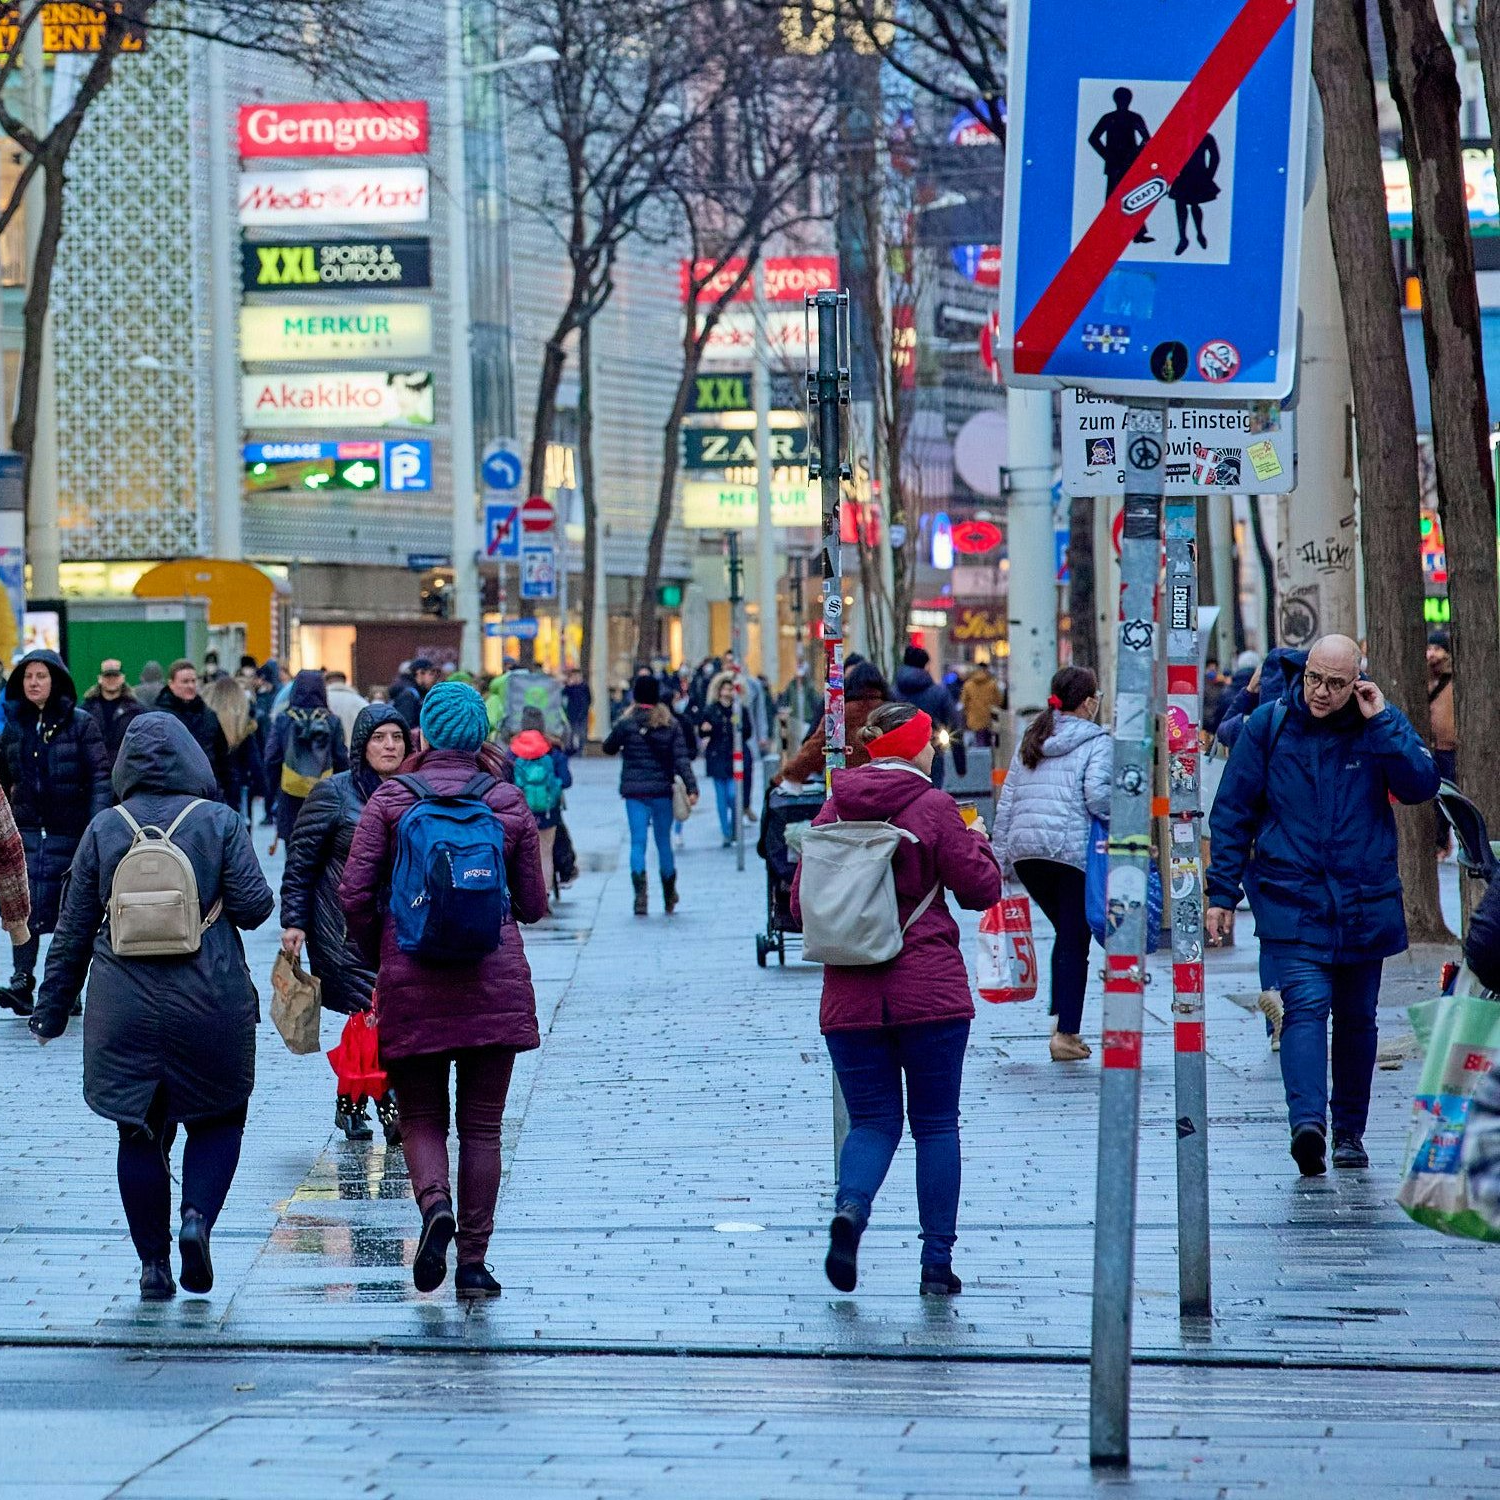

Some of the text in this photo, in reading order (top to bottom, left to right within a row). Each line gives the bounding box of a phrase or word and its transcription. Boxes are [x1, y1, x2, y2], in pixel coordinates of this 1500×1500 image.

[247, 109, 420, 151] Gerngross
[1129, 184, 1158, 206] KRAFT
[320, 245, 395, 263] SPORTS &
[256, 247, 319, 285] XXL
[320, 263, 402, 283] OUTDOOR
[284, 316, 389, 335] MERKUR
[256, 383, 383, 409] Akakiko
[696, 378, 747, 409] XXL
[1079, 414, 1115, 431] zum
[261, 444, 322, 459] GARAGE
[1164, 438, 1203, 457] owie
